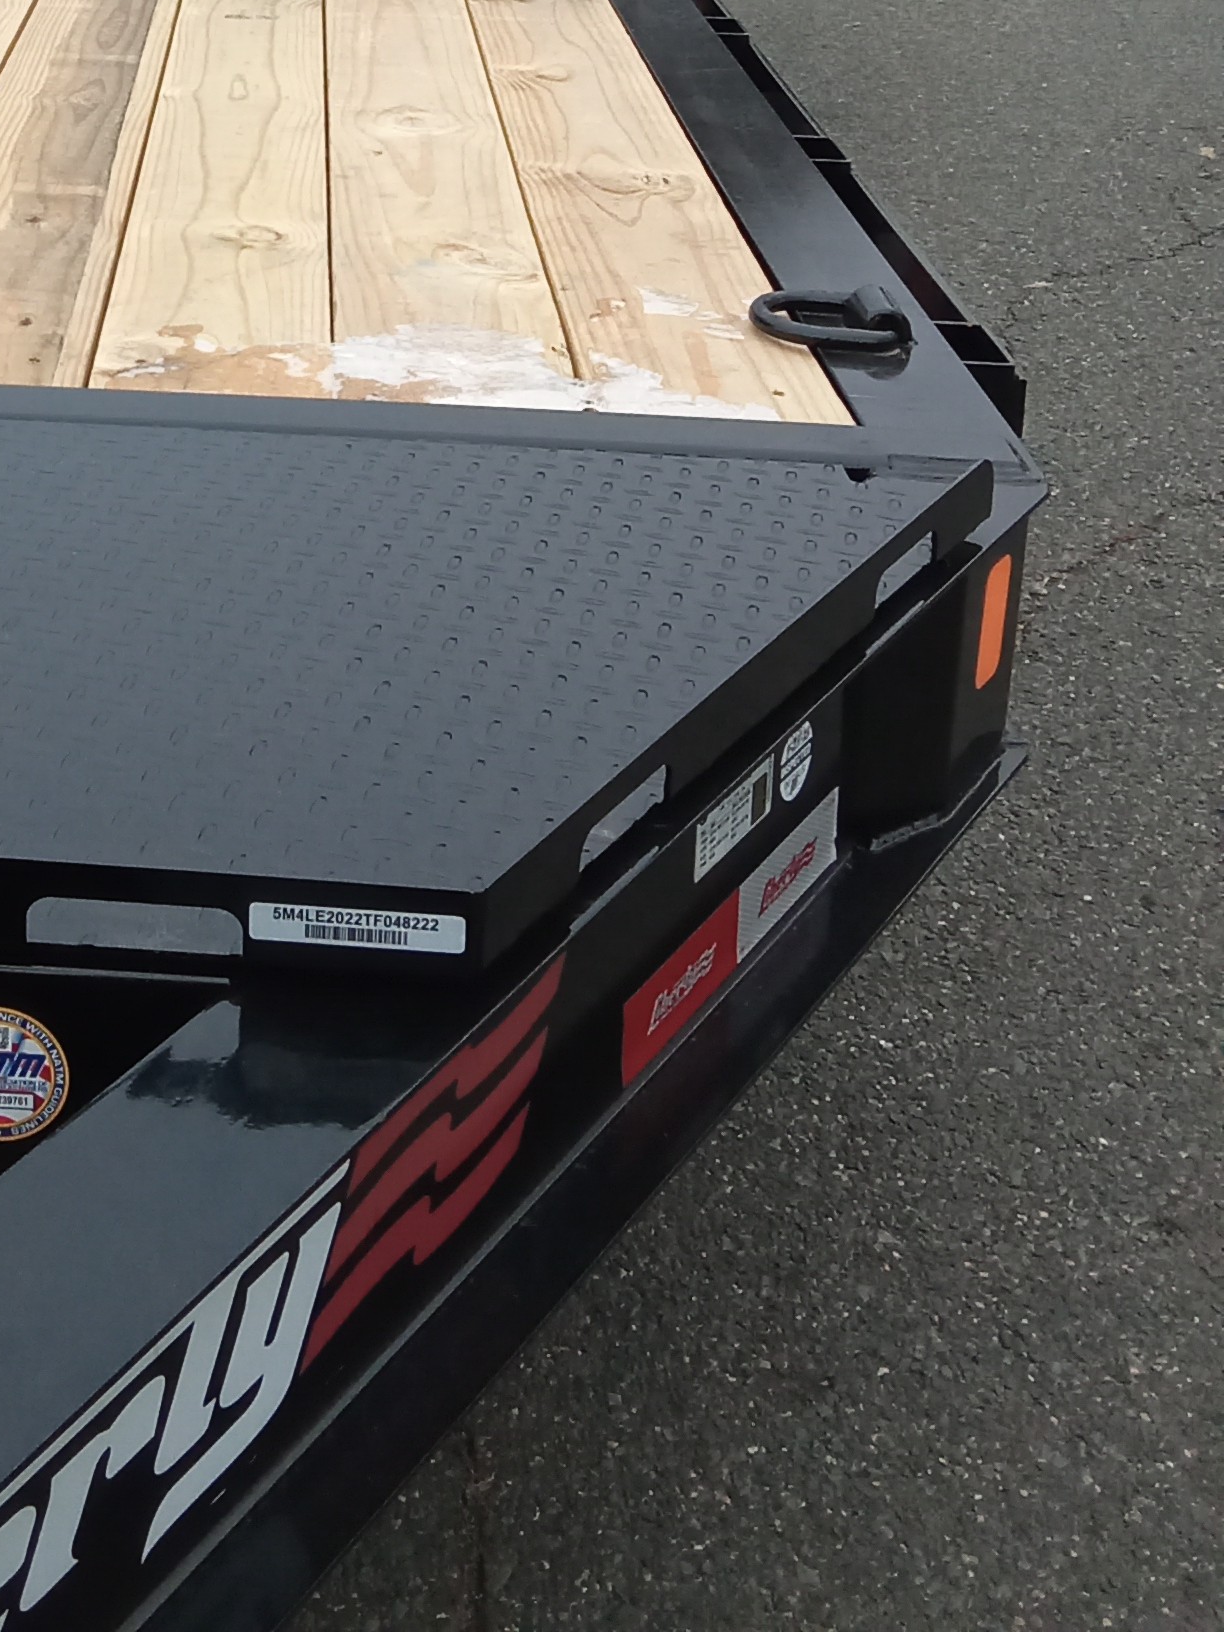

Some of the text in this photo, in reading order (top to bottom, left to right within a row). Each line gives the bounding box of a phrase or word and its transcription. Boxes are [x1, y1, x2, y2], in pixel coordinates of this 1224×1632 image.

[273, 906, 439, 932] 5M4LE2022TF048222
[25, 1021, 53, 1047] WITH
[49, 1047, 66, 1083] NATM
[10, 1086, 64, 1136] GUIDELINES
